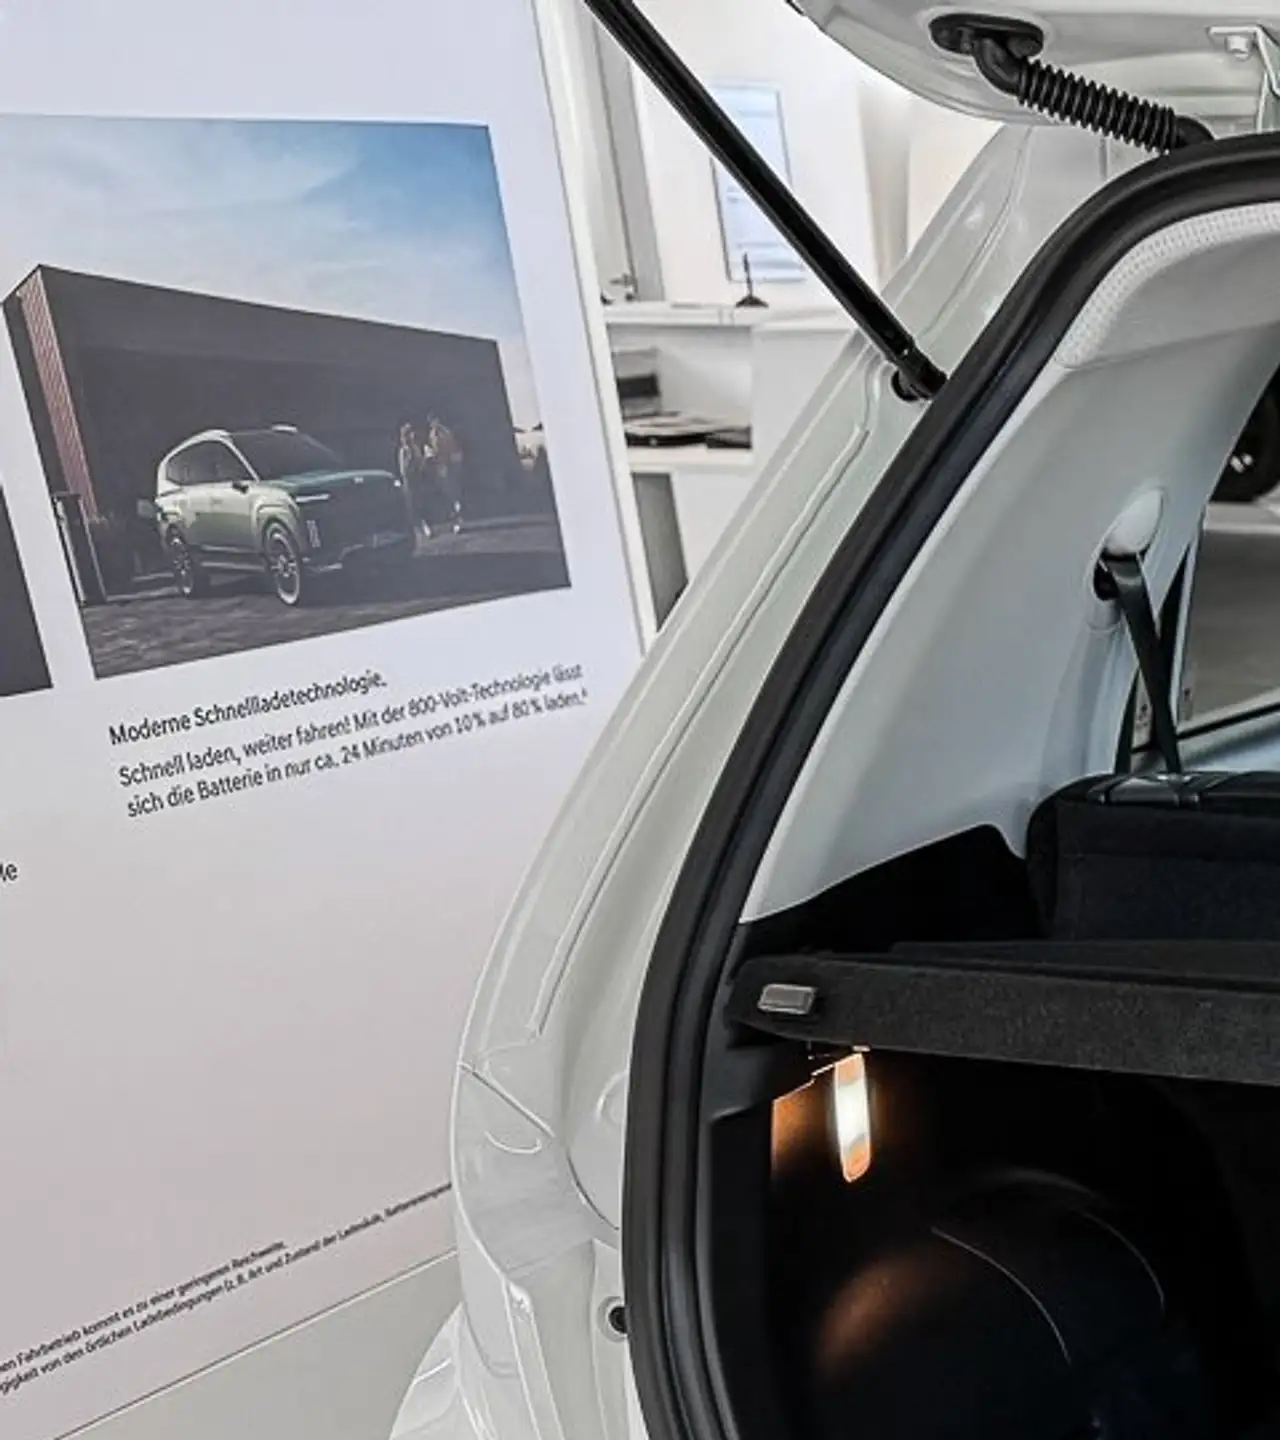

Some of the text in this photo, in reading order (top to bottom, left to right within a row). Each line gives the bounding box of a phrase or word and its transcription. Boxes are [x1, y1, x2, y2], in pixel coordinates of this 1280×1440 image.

[109, 669, 387, 745] Moderne Schnellladetechnologie.
[119, 753, 185, 788] Schnell
[187, 746, 241, 770] laden,
[242, 733, 293, 758] weiter
[296, 714, 350, 745] fahren!
[353, 709, 379, 733] Mit
[381, 705, 406, 725] der
[407, 671, 551, 718] 800-Volt-Technologie
[128, 792, 164, 818] sich
[167, 785, 196, 808] die
[197, 768, 263, 801] Batterie
[266, 763, 283, 782] in
[285, 757, 311, 780] nur
[315, 753, 339, 770] ca.
[341, 744, 361, 764] 24
[363, 729, 424, 760] Minuten
[425, 722, 453, 743] von
[489, 702, 509, 725] auf
[17, 1330, 81, 1365] Fahrbetrieb
[82, 1311, 121, 1336] kommt
[40, 1357, 62, 1374] von
[63, 1346, 85, 1365] den
